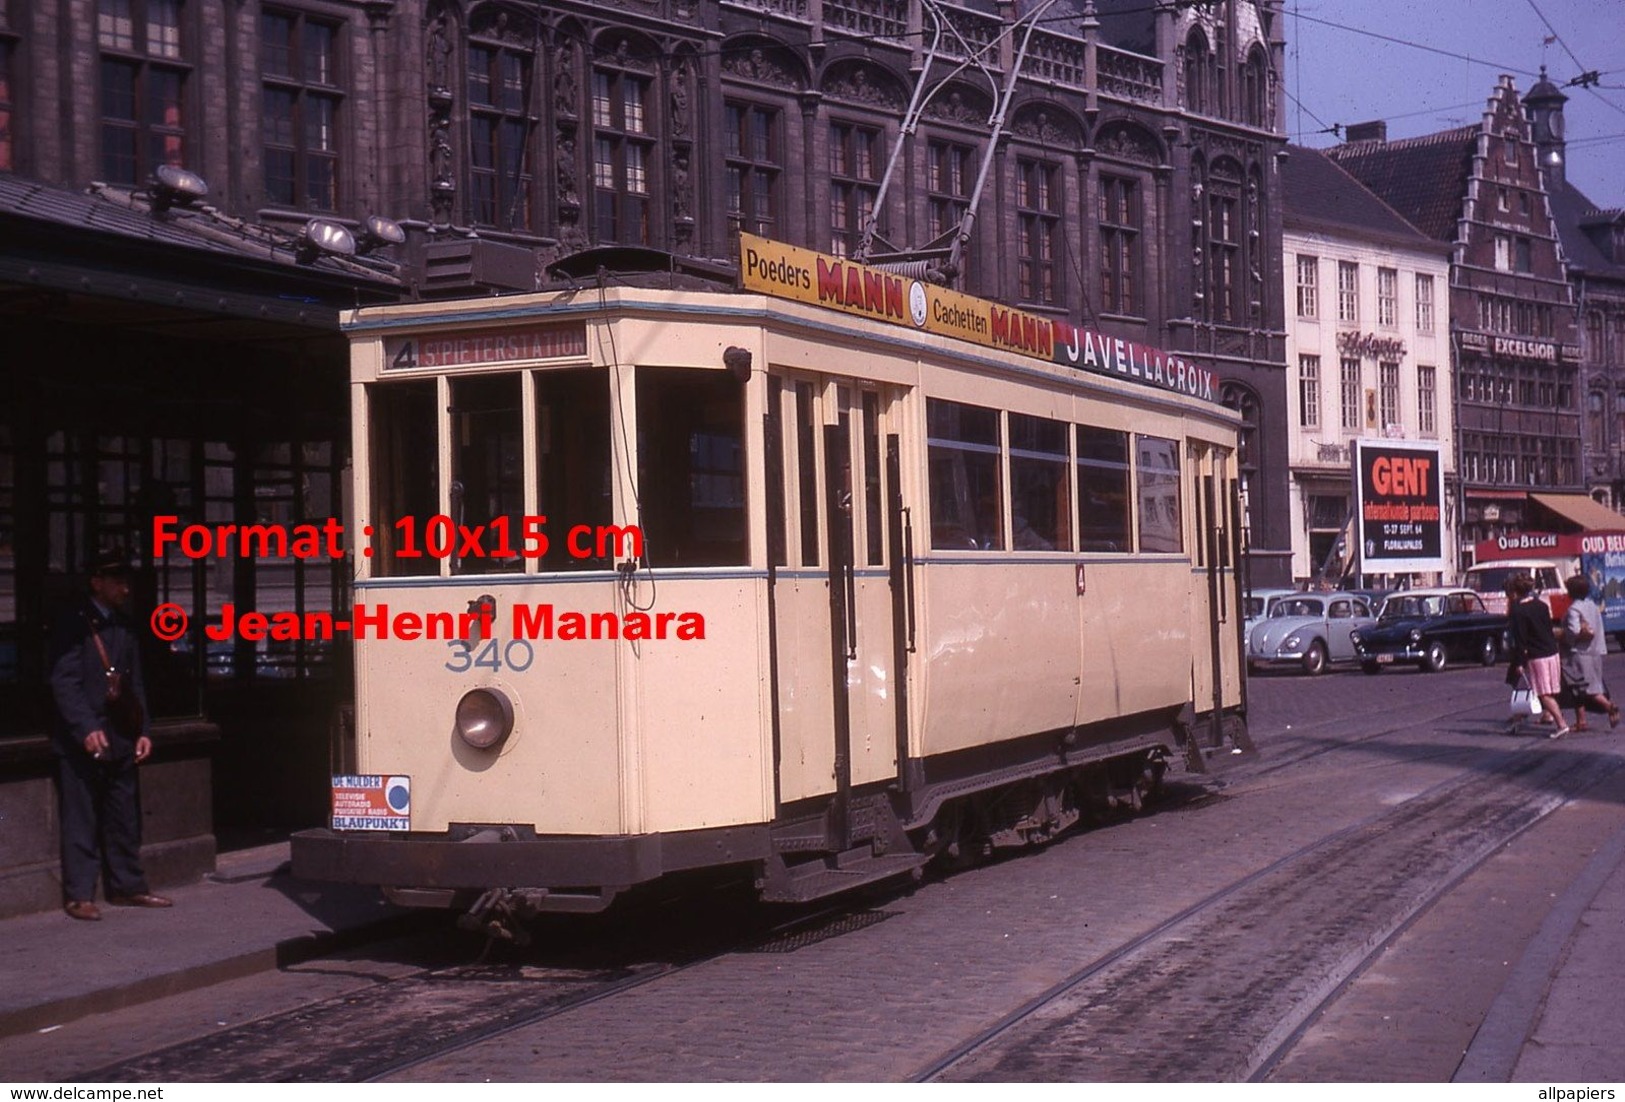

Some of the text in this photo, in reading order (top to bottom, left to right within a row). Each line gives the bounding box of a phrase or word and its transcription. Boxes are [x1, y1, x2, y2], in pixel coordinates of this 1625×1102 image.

[746, 248, 1051, 356] Poeders MANN Cachetten MANN
[393, 341, 416, 368] 4
[1066, 328, 1140, 377] JAVEL
[1495, 337, 1555, 360] EXCELSIOR
[1372, 456, 1430, 496] GENT
[1582, 537, 1605, 553] OUD
[444, 638, 535, 674] 340
[334, 816, 408, 829] BLAUPUNKT
